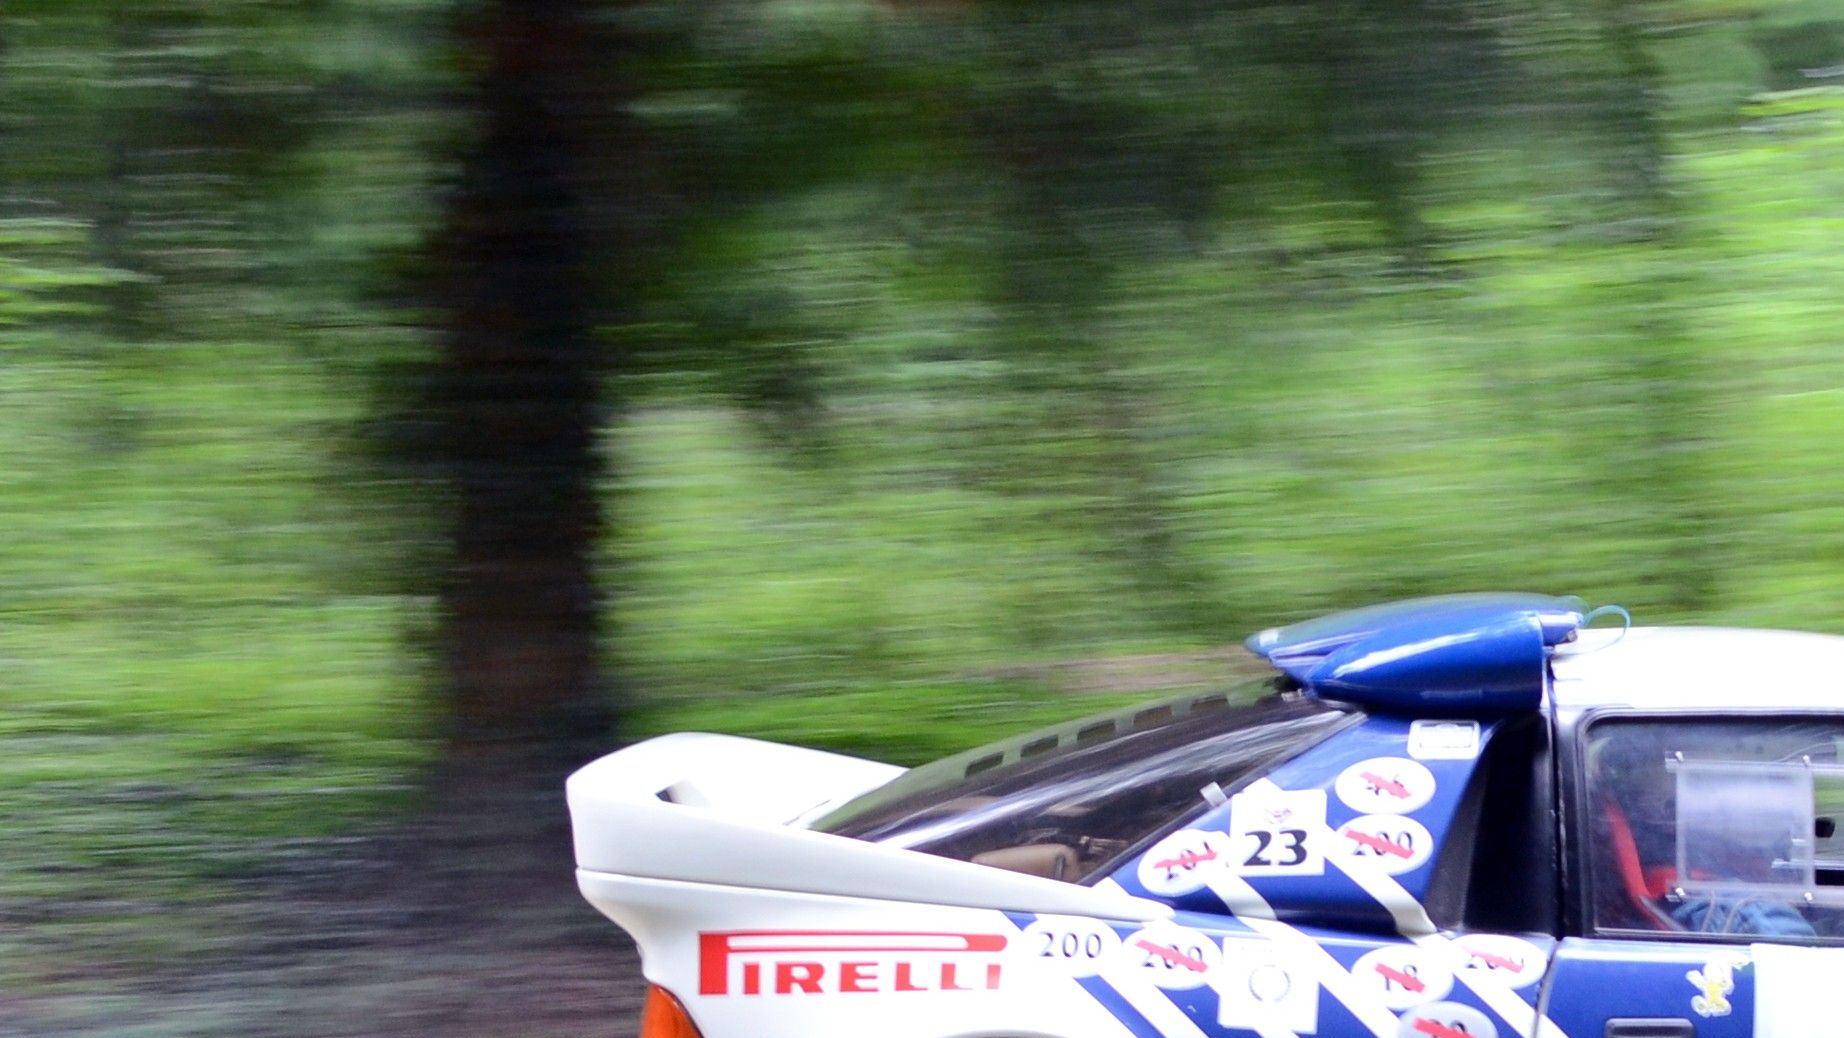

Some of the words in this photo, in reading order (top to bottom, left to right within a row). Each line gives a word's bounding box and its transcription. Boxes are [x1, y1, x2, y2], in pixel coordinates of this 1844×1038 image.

[1243, 829, 1308, 866] 23
[698, 930, 1008, 997] PIRELLI
[1039, 931, 1103, 959] 200
